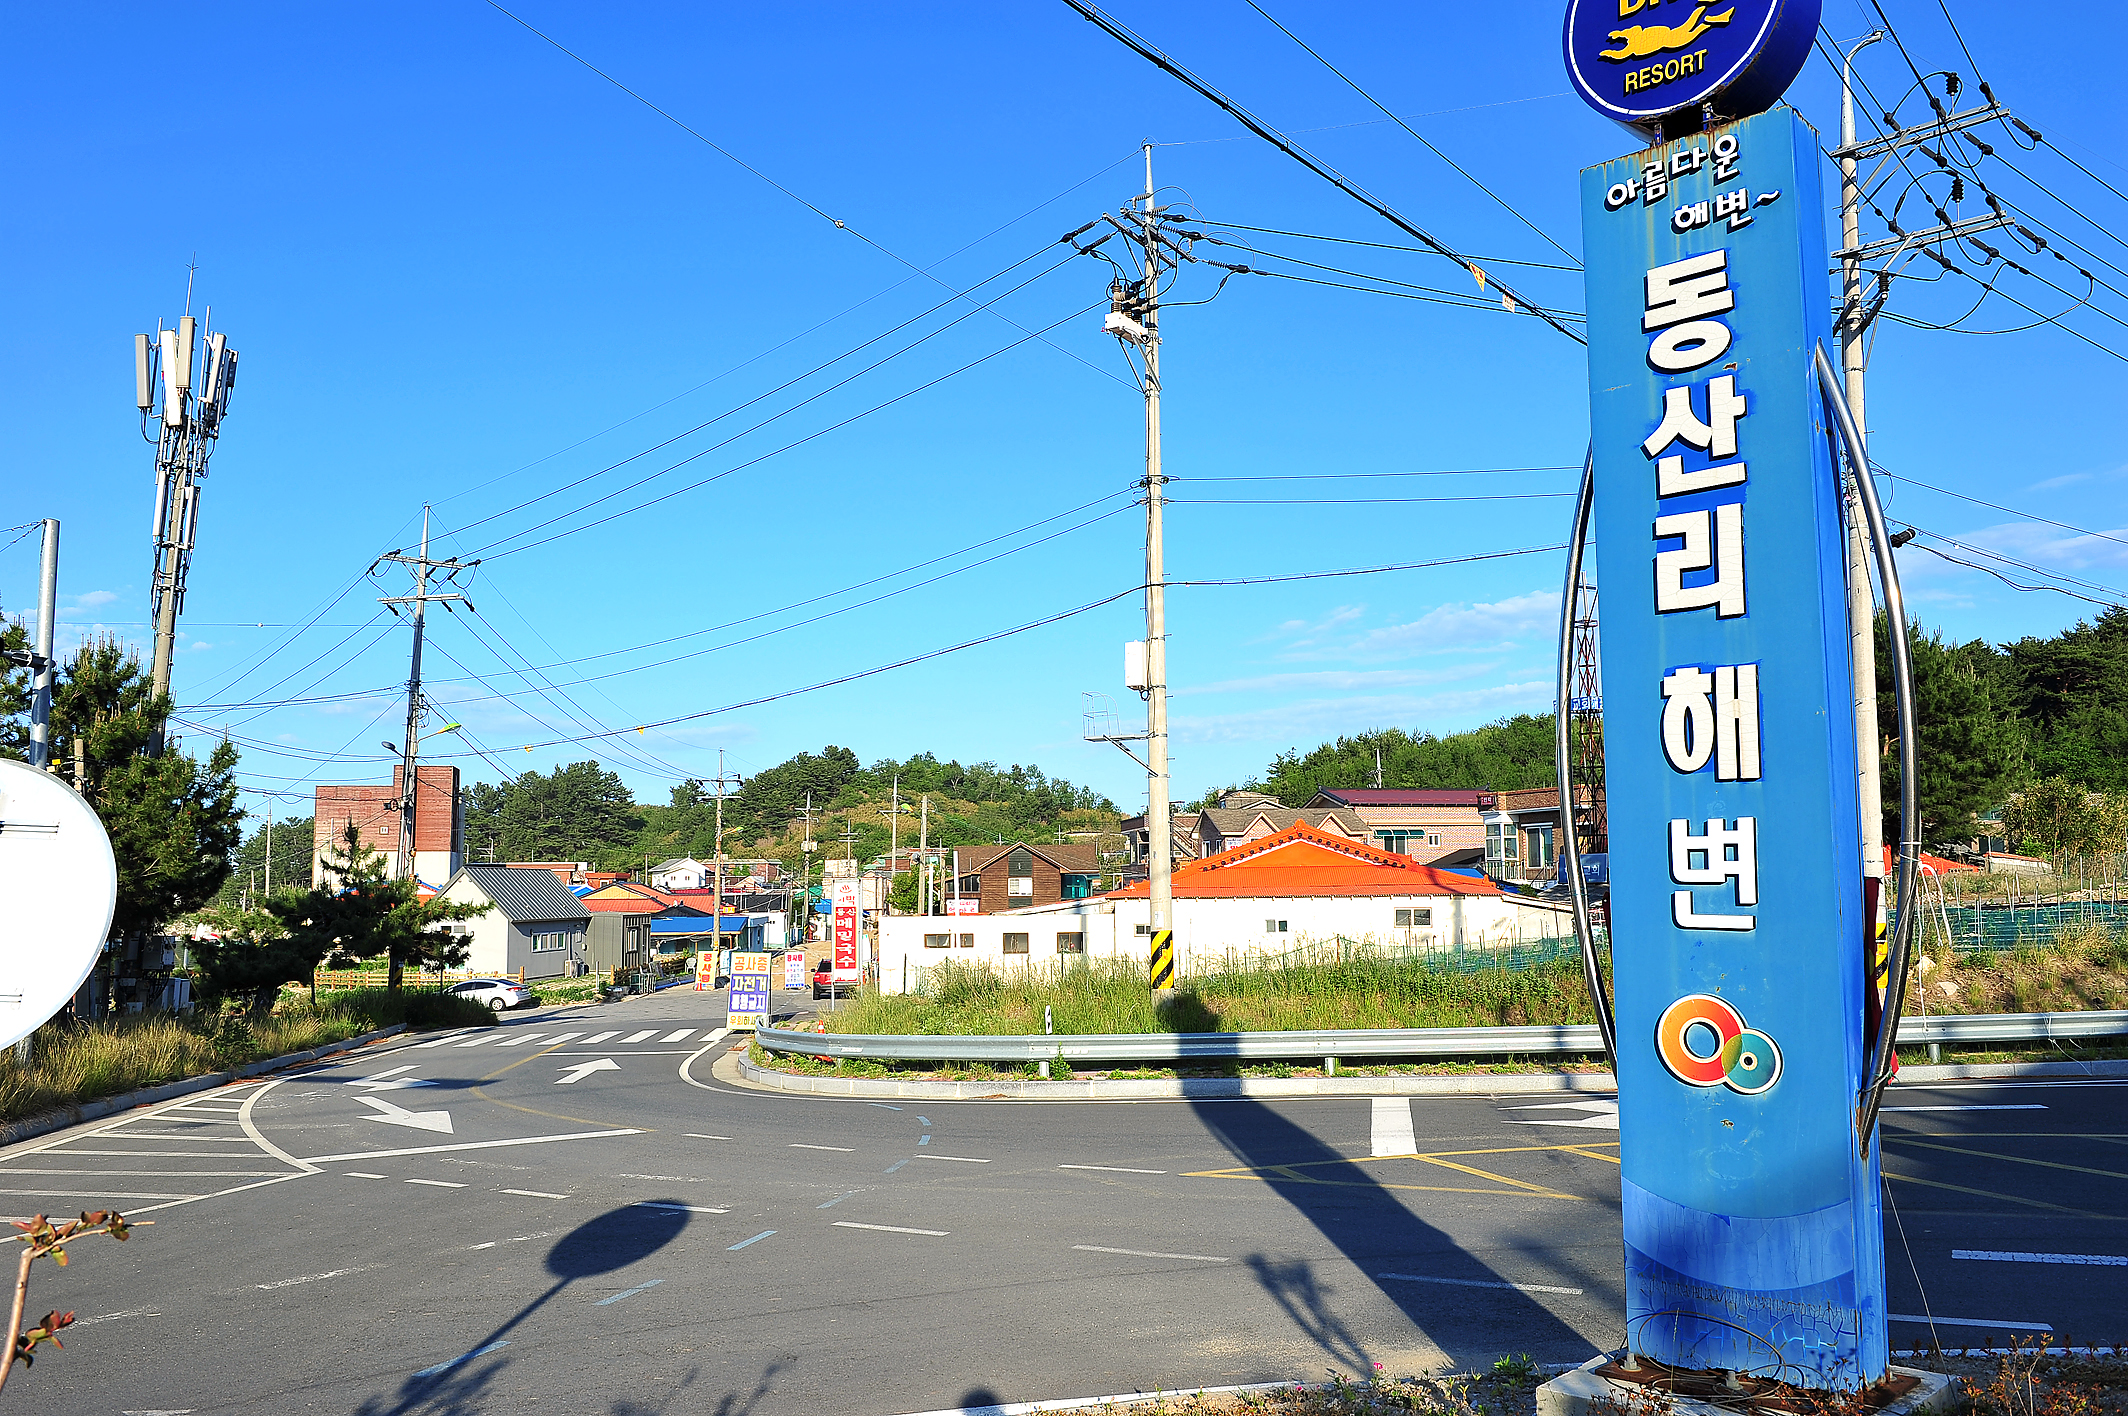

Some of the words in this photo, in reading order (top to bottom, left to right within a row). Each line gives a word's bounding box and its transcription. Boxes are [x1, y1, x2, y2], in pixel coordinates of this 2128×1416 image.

[1624, 49, 1709, 95] RESORT
[1604, 134, 1740, 211] 아름다운
[835, 917, 857, 968] 메밀국수
[734, 956, 768, 971] 공사중
[731, 975, 768, 992] 자전거
[730, 1015, 758, 1026] 우회하시
